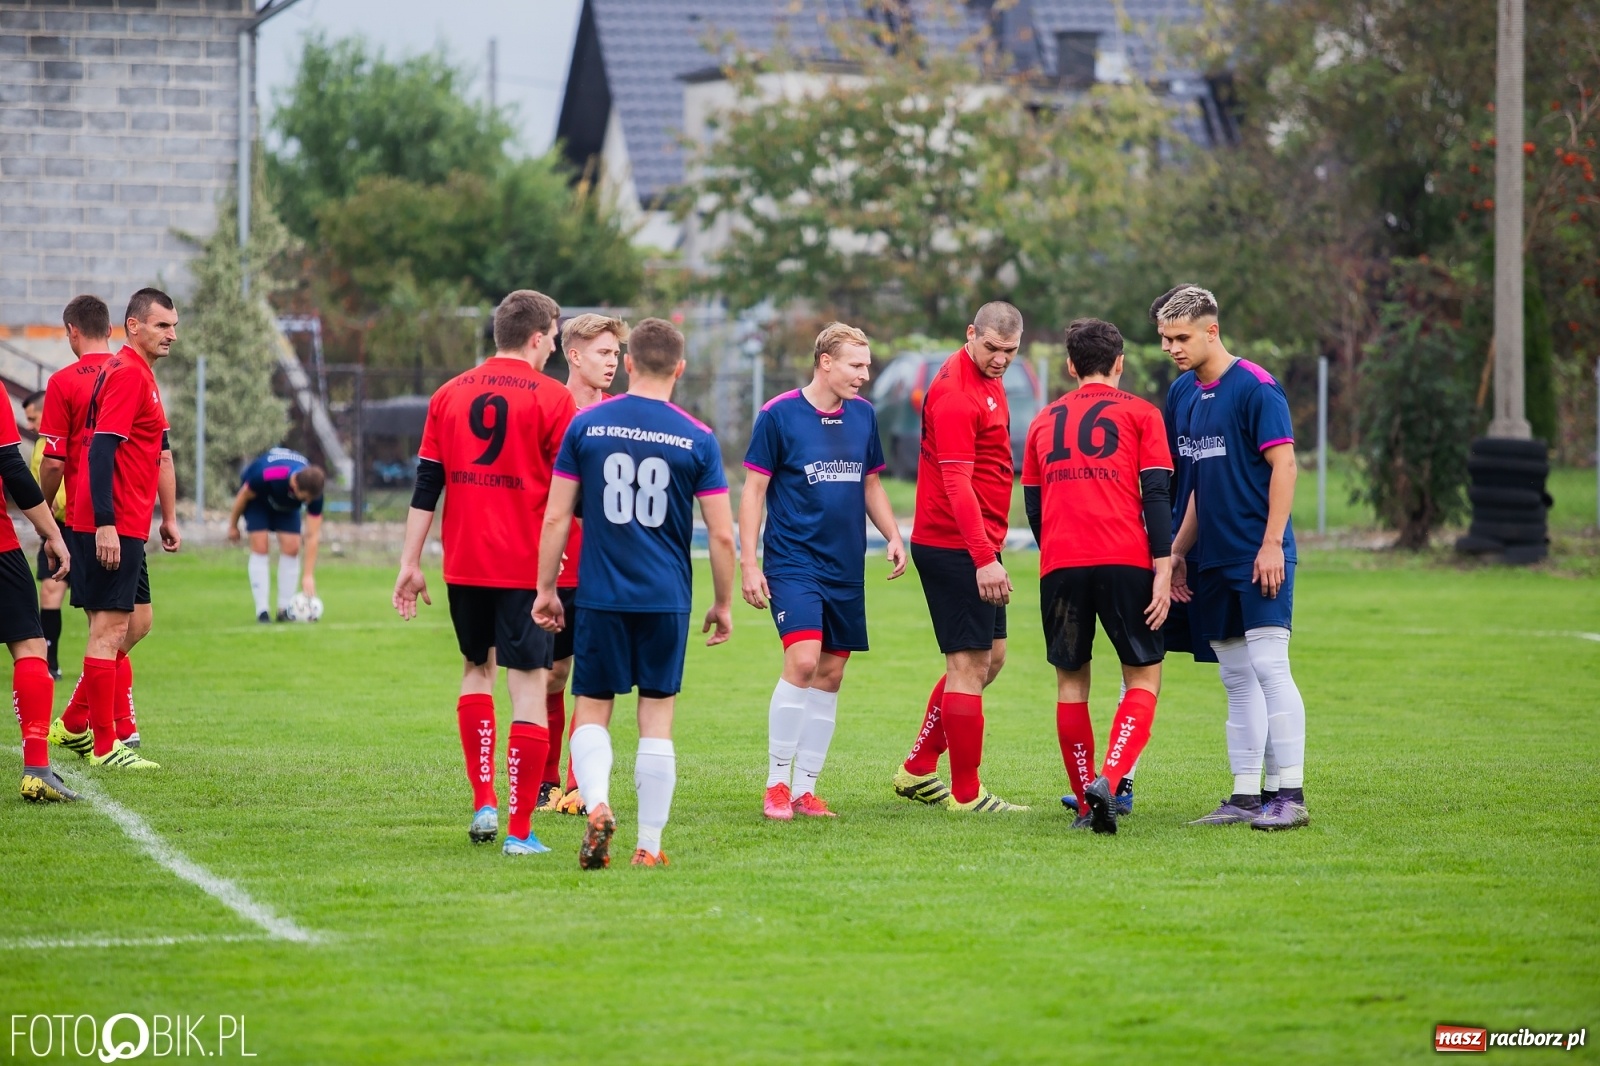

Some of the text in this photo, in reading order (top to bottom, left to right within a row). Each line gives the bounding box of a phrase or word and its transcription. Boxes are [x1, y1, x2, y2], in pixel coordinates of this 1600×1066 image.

[469, 391, 508, 465] 9
[586, 426, 694, 450] LKS KRZYŻANOWICE
[1046, 400, 1120, 465] 16
[603, 452, 670, 528] 88
[824, 459, 862, 473] KÜHN
[477, 719, 493, 782] TWORKÓW
[1072, 742, 1092, 796] TWORKÓ
